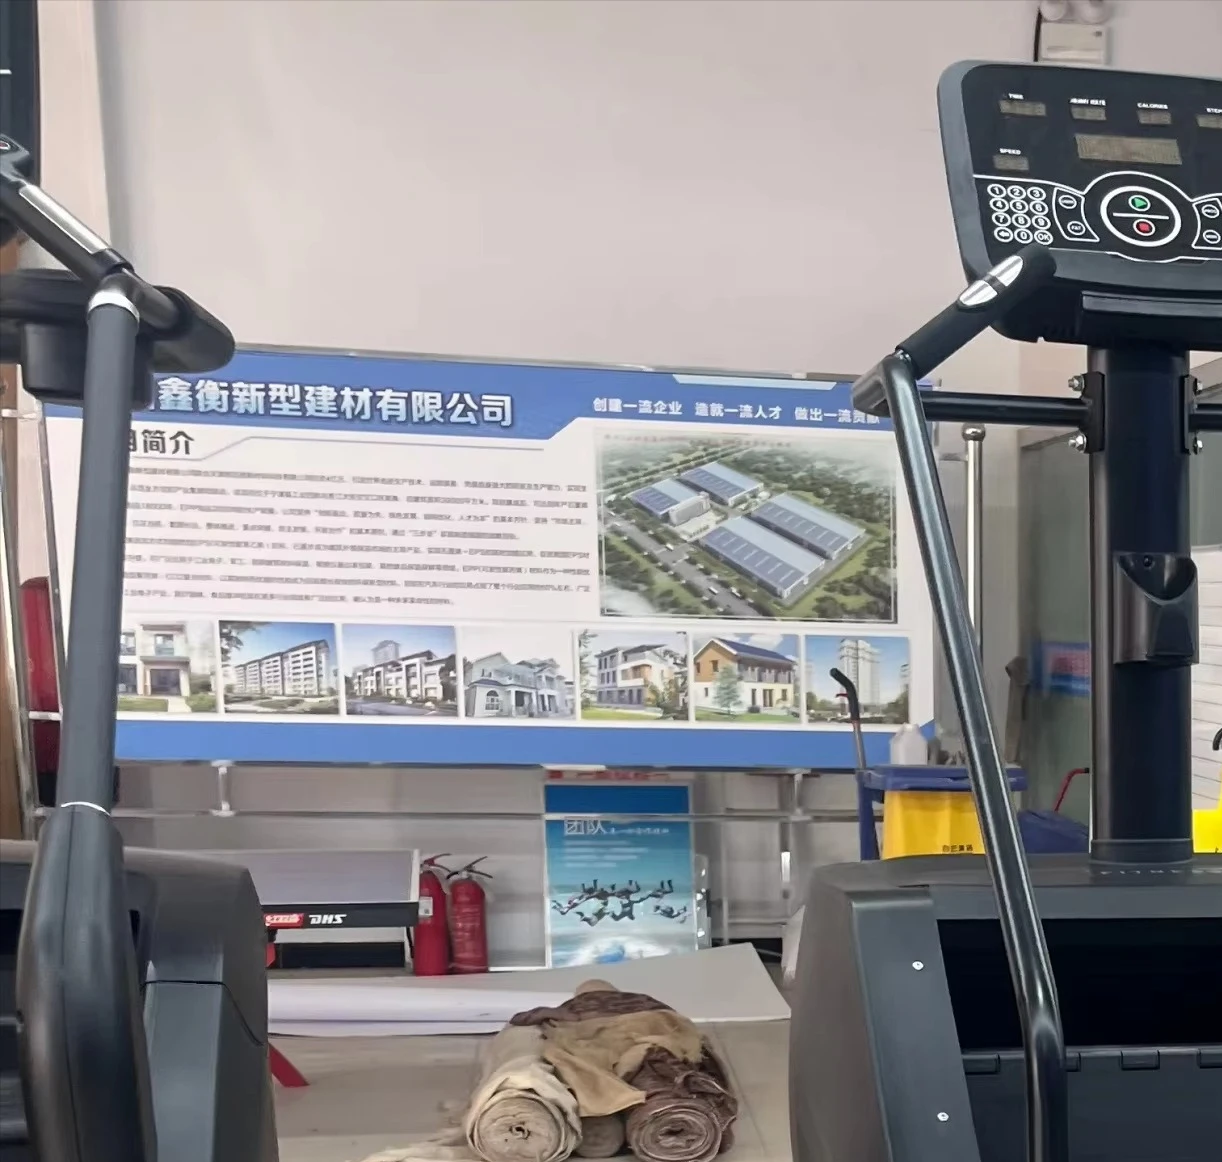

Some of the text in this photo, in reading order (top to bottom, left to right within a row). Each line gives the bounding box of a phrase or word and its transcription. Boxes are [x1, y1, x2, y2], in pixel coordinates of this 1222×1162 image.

[1037, 233, 1050, 241] OK
[150, 376, 512, 427] 鑫衡新型建材有限公司
[592, 397, 683, 415] 创建一流企业
[564, 816, 608, 836] 团队
[308, 914, 348, 925] DHS
